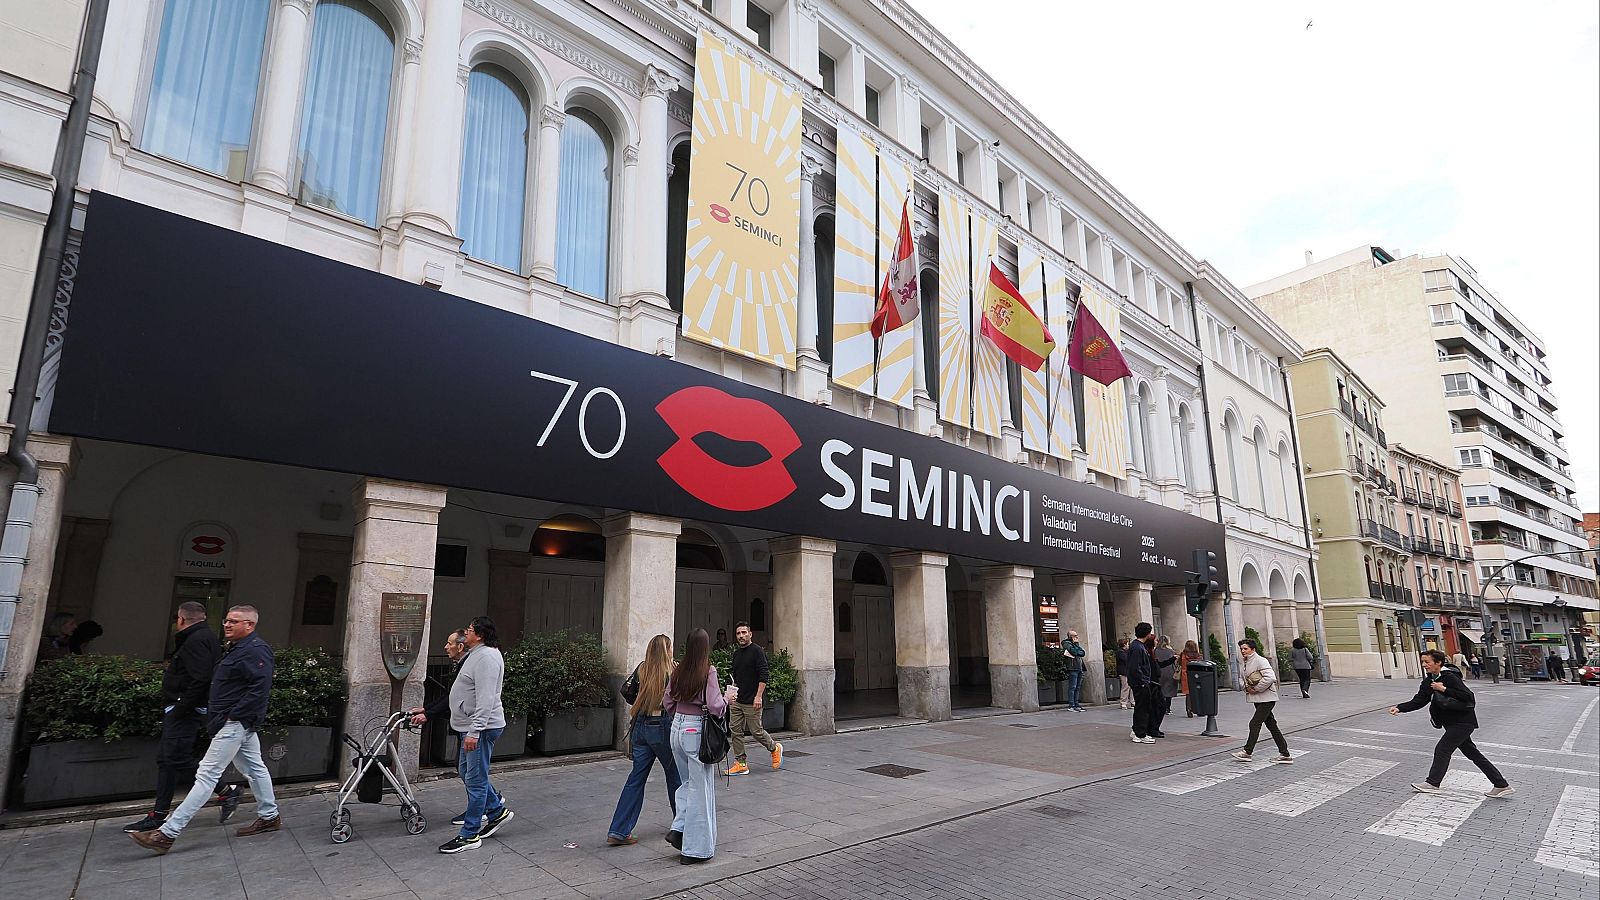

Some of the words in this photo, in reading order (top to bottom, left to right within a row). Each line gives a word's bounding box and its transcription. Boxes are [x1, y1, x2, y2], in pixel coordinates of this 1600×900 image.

[726, 162, 770, 217] 70
[734, 215, 782, 248] SEMINCI
[530, 370, 627, 459] 70
[819, 438, 1031, 543] SEMINCI
[1042, 494, 1071, 512] Semana
[1072, 502, 1111, 522] Internacional
[1111, 512, 1120, 524] de
[1120, 515, 1133, 528] Cine
[1042, 513, 1077, 533] Valladolid
[1042, 533, 1084, 552] International
[1085, 541, 1098, 555] Film
[1099, 544, 1121, 558] Festival
[1141, 535, 1155, 548] 2025
[185, 560, 226, 569] TAQUILLA
[1141, 552, 1149, 563] 24
[1149, 553, 1160, 564] oct.
[1166, 558, 1178, 568] nov.
